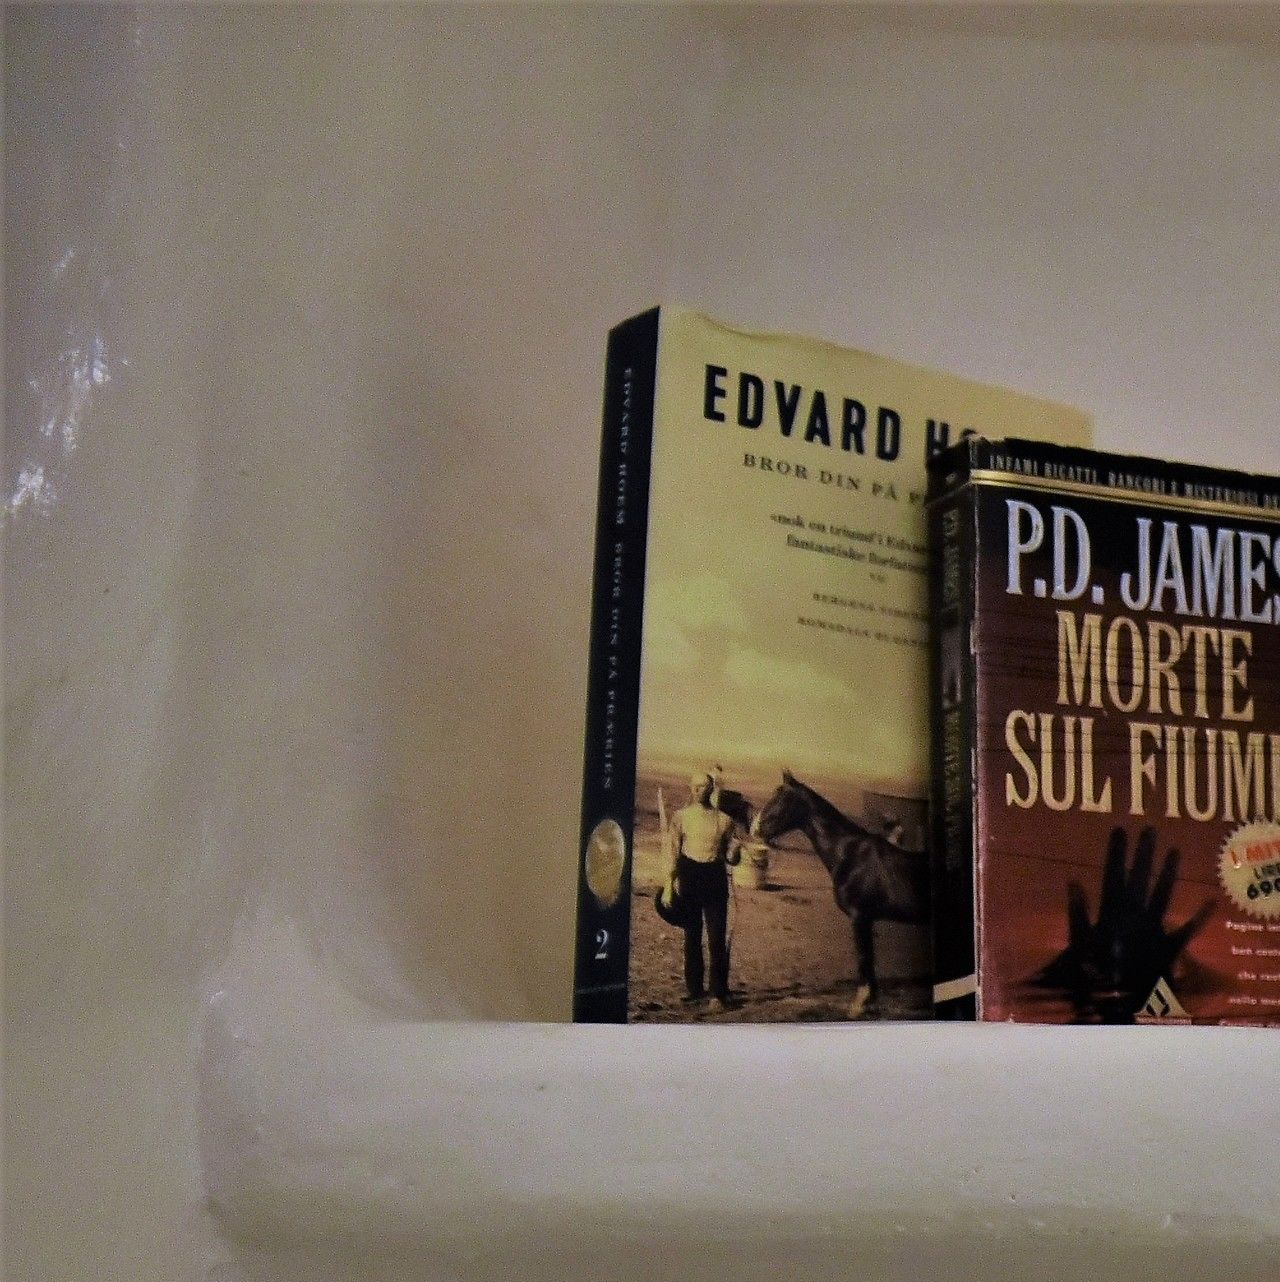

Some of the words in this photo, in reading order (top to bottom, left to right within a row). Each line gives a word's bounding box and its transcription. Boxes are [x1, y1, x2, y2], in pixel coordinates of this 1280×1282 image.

[703, 364, 900, 462] EDVARD
[743, 453, 808, 480] BROR
[819, 469, 861, 491] DIN
[1006, 499, 1104, 605] P.D.
[1056, 610, 1254, 722] MORTE
[1005, 710, 1112, 813] SUL
